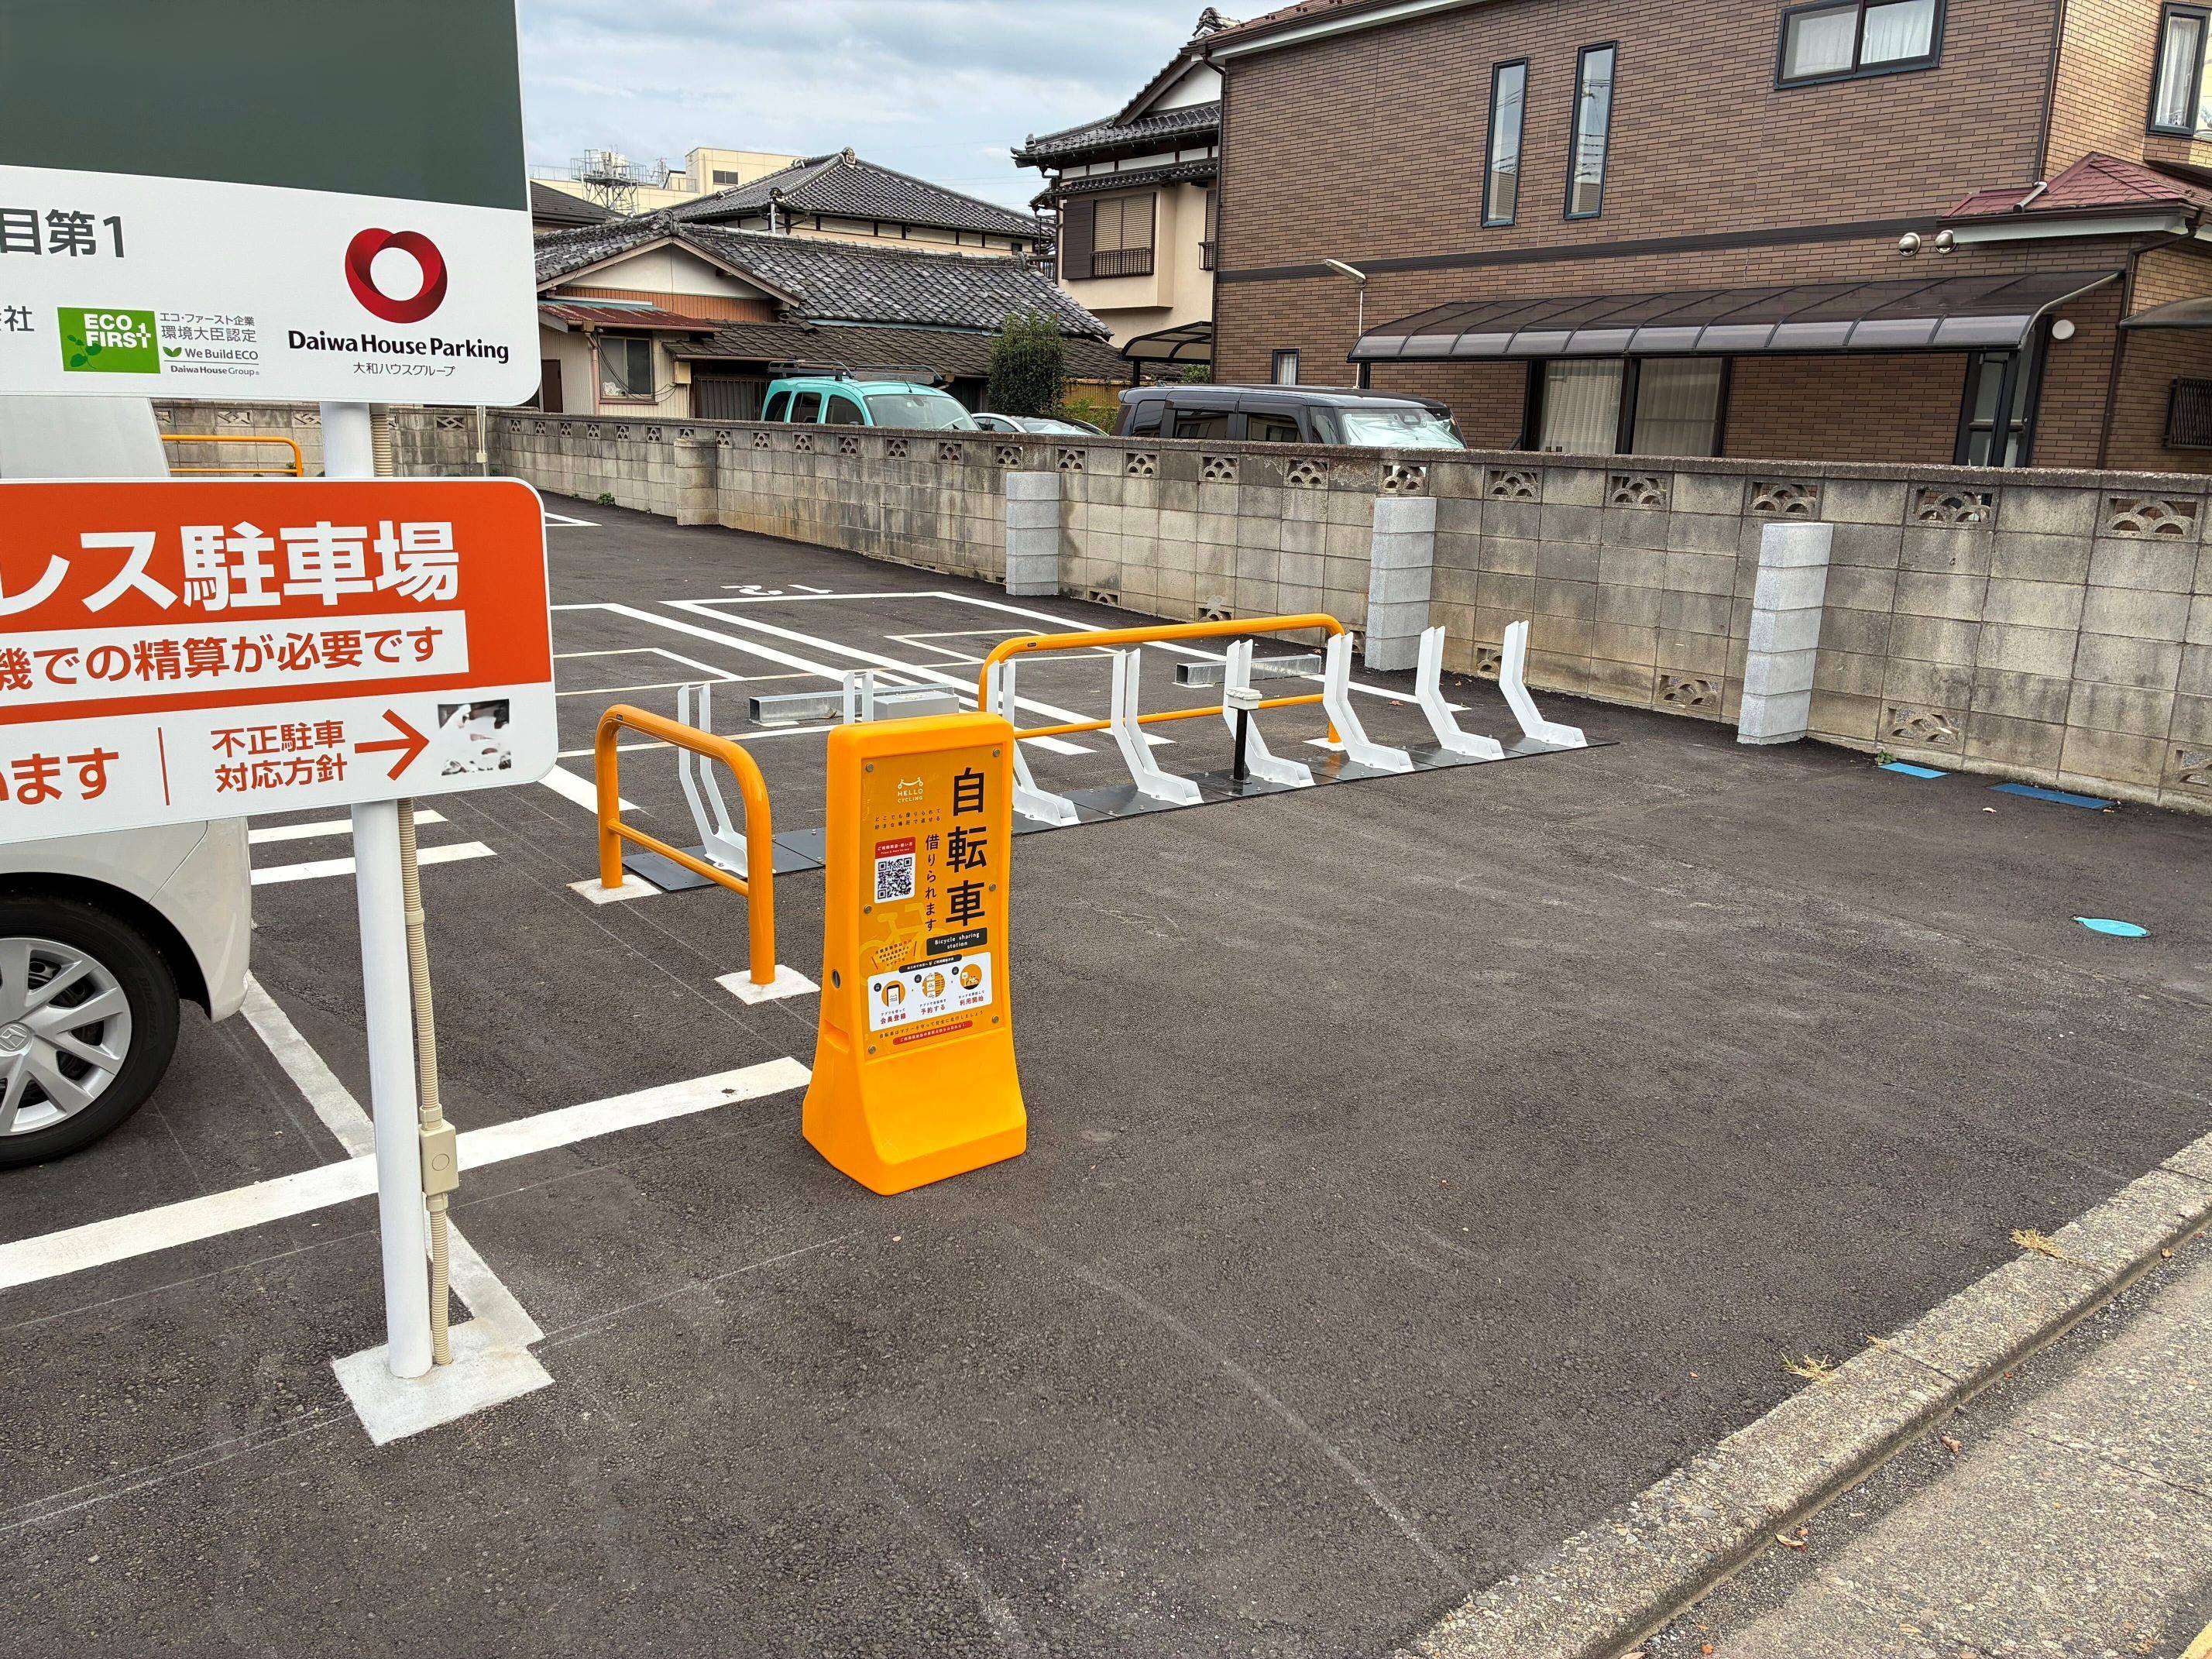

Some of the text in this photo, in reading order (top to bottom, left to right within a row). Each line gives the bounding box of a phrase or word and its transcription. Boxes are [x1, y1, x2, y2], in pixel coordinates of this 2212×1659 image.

[0, 208, 124, 258] 目第1
[0, 305, 35, 331] 社
[84, 313, 132, 331] ECO
[160, 312, 255, 327] エコ・ファースト企業
[85, 323, 152, 349] FIRST
[161, 325, 257, 343] 環境大臣認定
[288, 330, 510, 364] Daiwa House Parking
[184, 349, 259, 361] We Build ECO
[170, 365, 199, 374] Daiwa
[200, 366, 227, 375] House
[353, 361, 455, 377] 大和ハウスグループ
[0, 520, 460, 617] レス駐車場
[211, 720, 346, 760] 不正駐車
[0, 747, 119, 805] ます
[215, 754, 348, 795] 対応方針
[897, 788, 923, 797] HELLO
[946, 767, 988, 927] 自転車
[925, 833, 940, 932] 借りられます
[934, 932, 980, 946] Bicycle sharing
[946, 941, 968, 950] station
